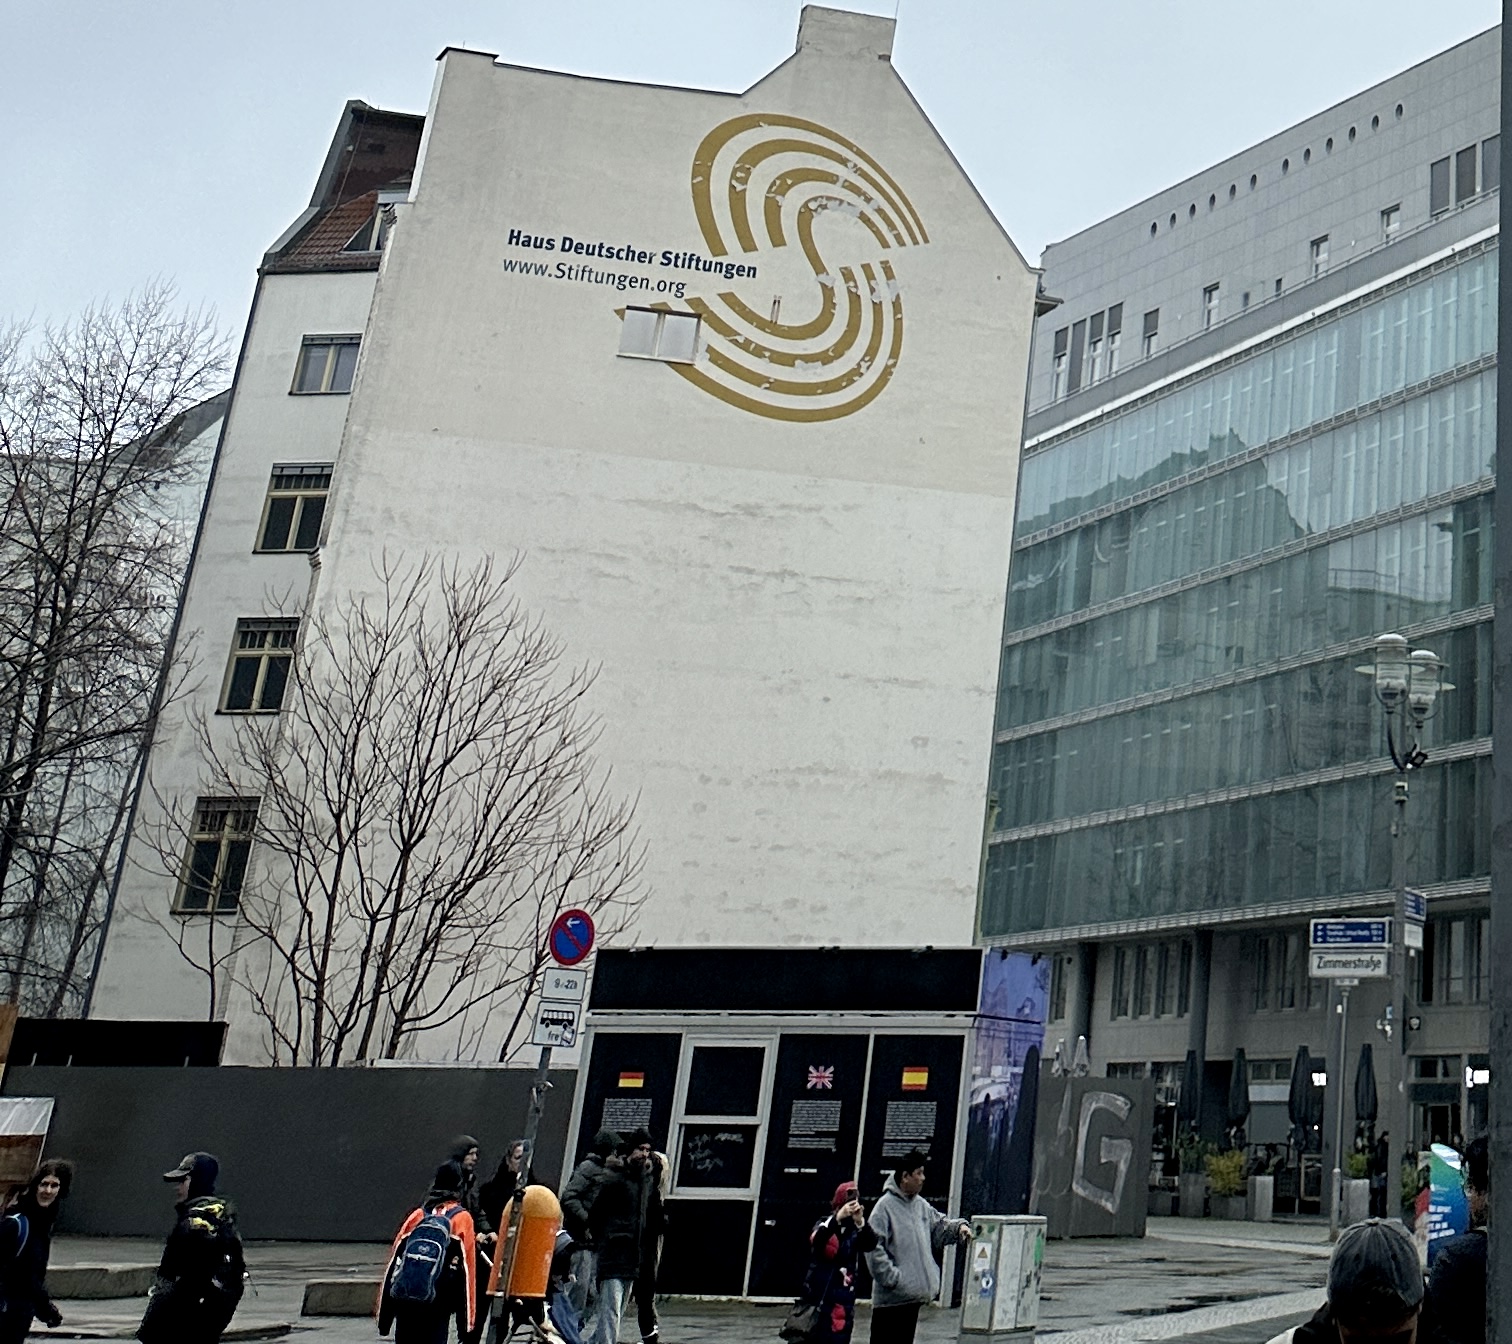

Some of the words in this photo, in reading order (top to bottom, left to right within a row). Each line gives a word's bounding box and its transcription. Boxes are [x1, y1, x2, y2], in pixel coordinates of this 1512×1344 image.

[507, 228, 556, 251] Haus
[560, 235, 657, 264] Deutscher
[659, 250, 758, 280] Stiftungen
[503, 257, 688, 299] www.Stiftungen.org
[1316, 954, 1382, 972] Zimmerstraße
